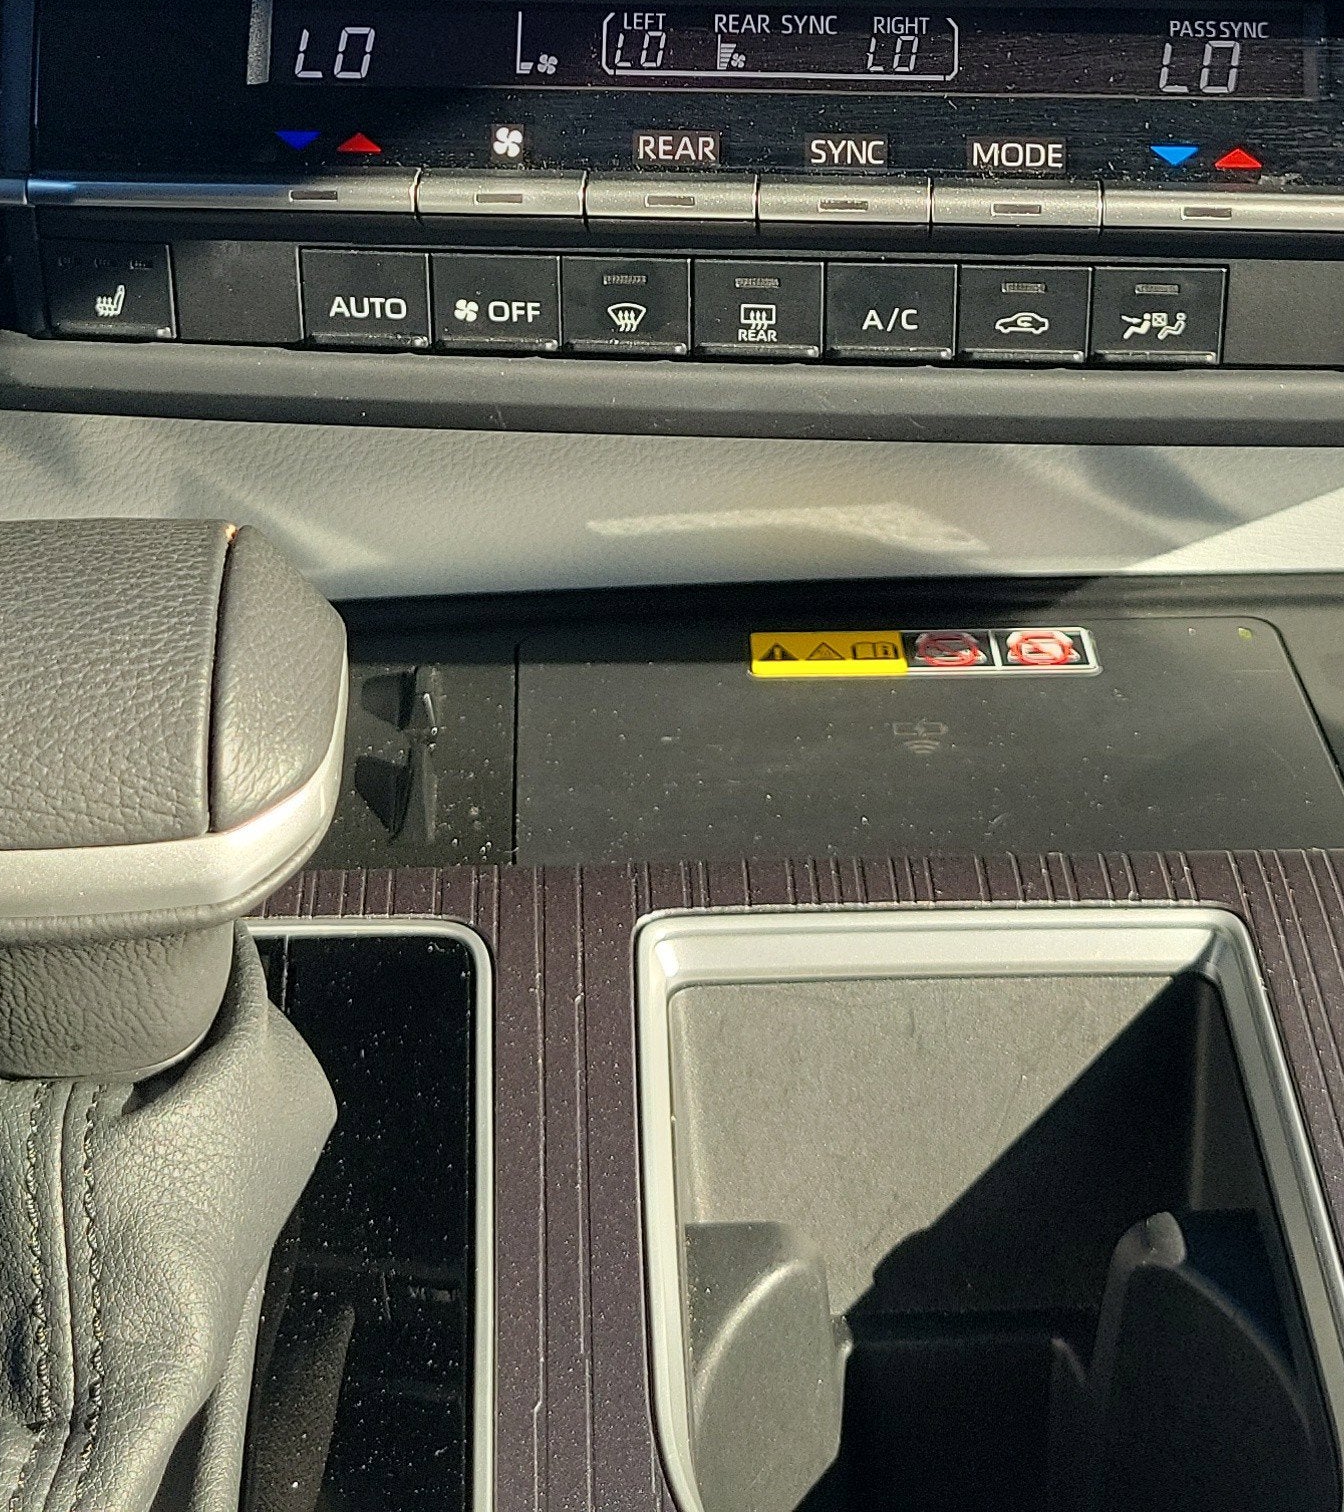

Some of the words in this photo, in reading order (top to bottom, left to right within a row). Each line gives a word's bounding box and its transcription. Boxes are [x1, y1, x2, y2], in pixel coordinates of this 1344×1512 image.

[623, 13, 666, 30] LEFT
[714, 14, 770, 34] REAR
[781, 15, 837, 35] SYNC
[873, 16, 930, 35] RIGHT
[1169, 20, 1216, 38] PASS
[1219, 21, 1269, 39] SYNC
[294, 26, 376, 79] LO
[1159, 40, 1240, 94] LO
[637, 135, 716, 162] REAR
[810, 139, 885, 165] SYNC
[971, 141, 1063, 169] MODE
[329, 296, 408, 320] AUTO
[488, 301, 541, 323] OFF
[862, 307, 920, 333] A/C
[738, 330, 779, 343] REAR
